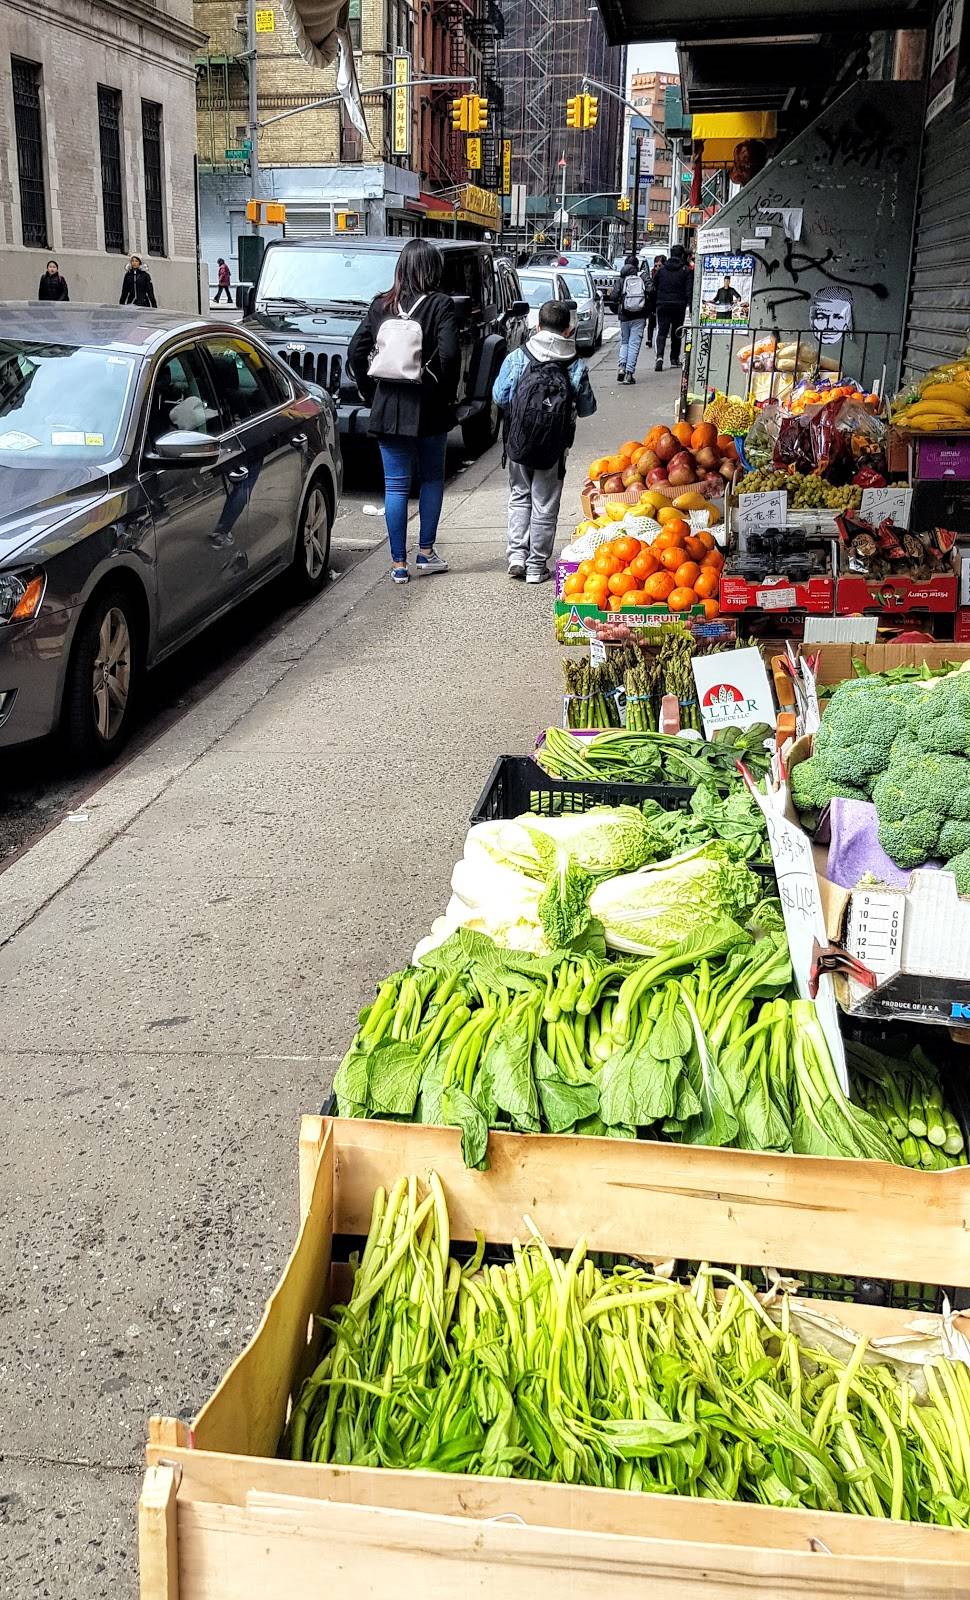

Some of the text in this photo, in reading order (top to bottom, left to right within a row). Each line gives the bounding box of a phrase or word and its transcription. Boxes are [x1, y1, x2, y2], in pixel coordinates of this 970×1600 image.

[710, 256, 753, 269] 寿司学校
[286, 342, 306, 352] Jeep
[743, 492, 766, 508] 5.50
[866, 488, 889, 506] 3.99
[908, 591, 929, 599] Cherry
[733, 598, 748, 606] miss
[608, 614, 680, 623] FRESH FRUIT
[706, 712, 750, 724] PRODUCE LLC
[864, 897, 870, 905] 9
[860, 910, 869, 919] 10
[858, 924, 867, 932] 11
[889, 910, 899, 955] COUNT
[857, 937, 867, 946] 12
[856, 951, 866, 960] 13
[881, 1000, 911, 1009] PRODUCE
